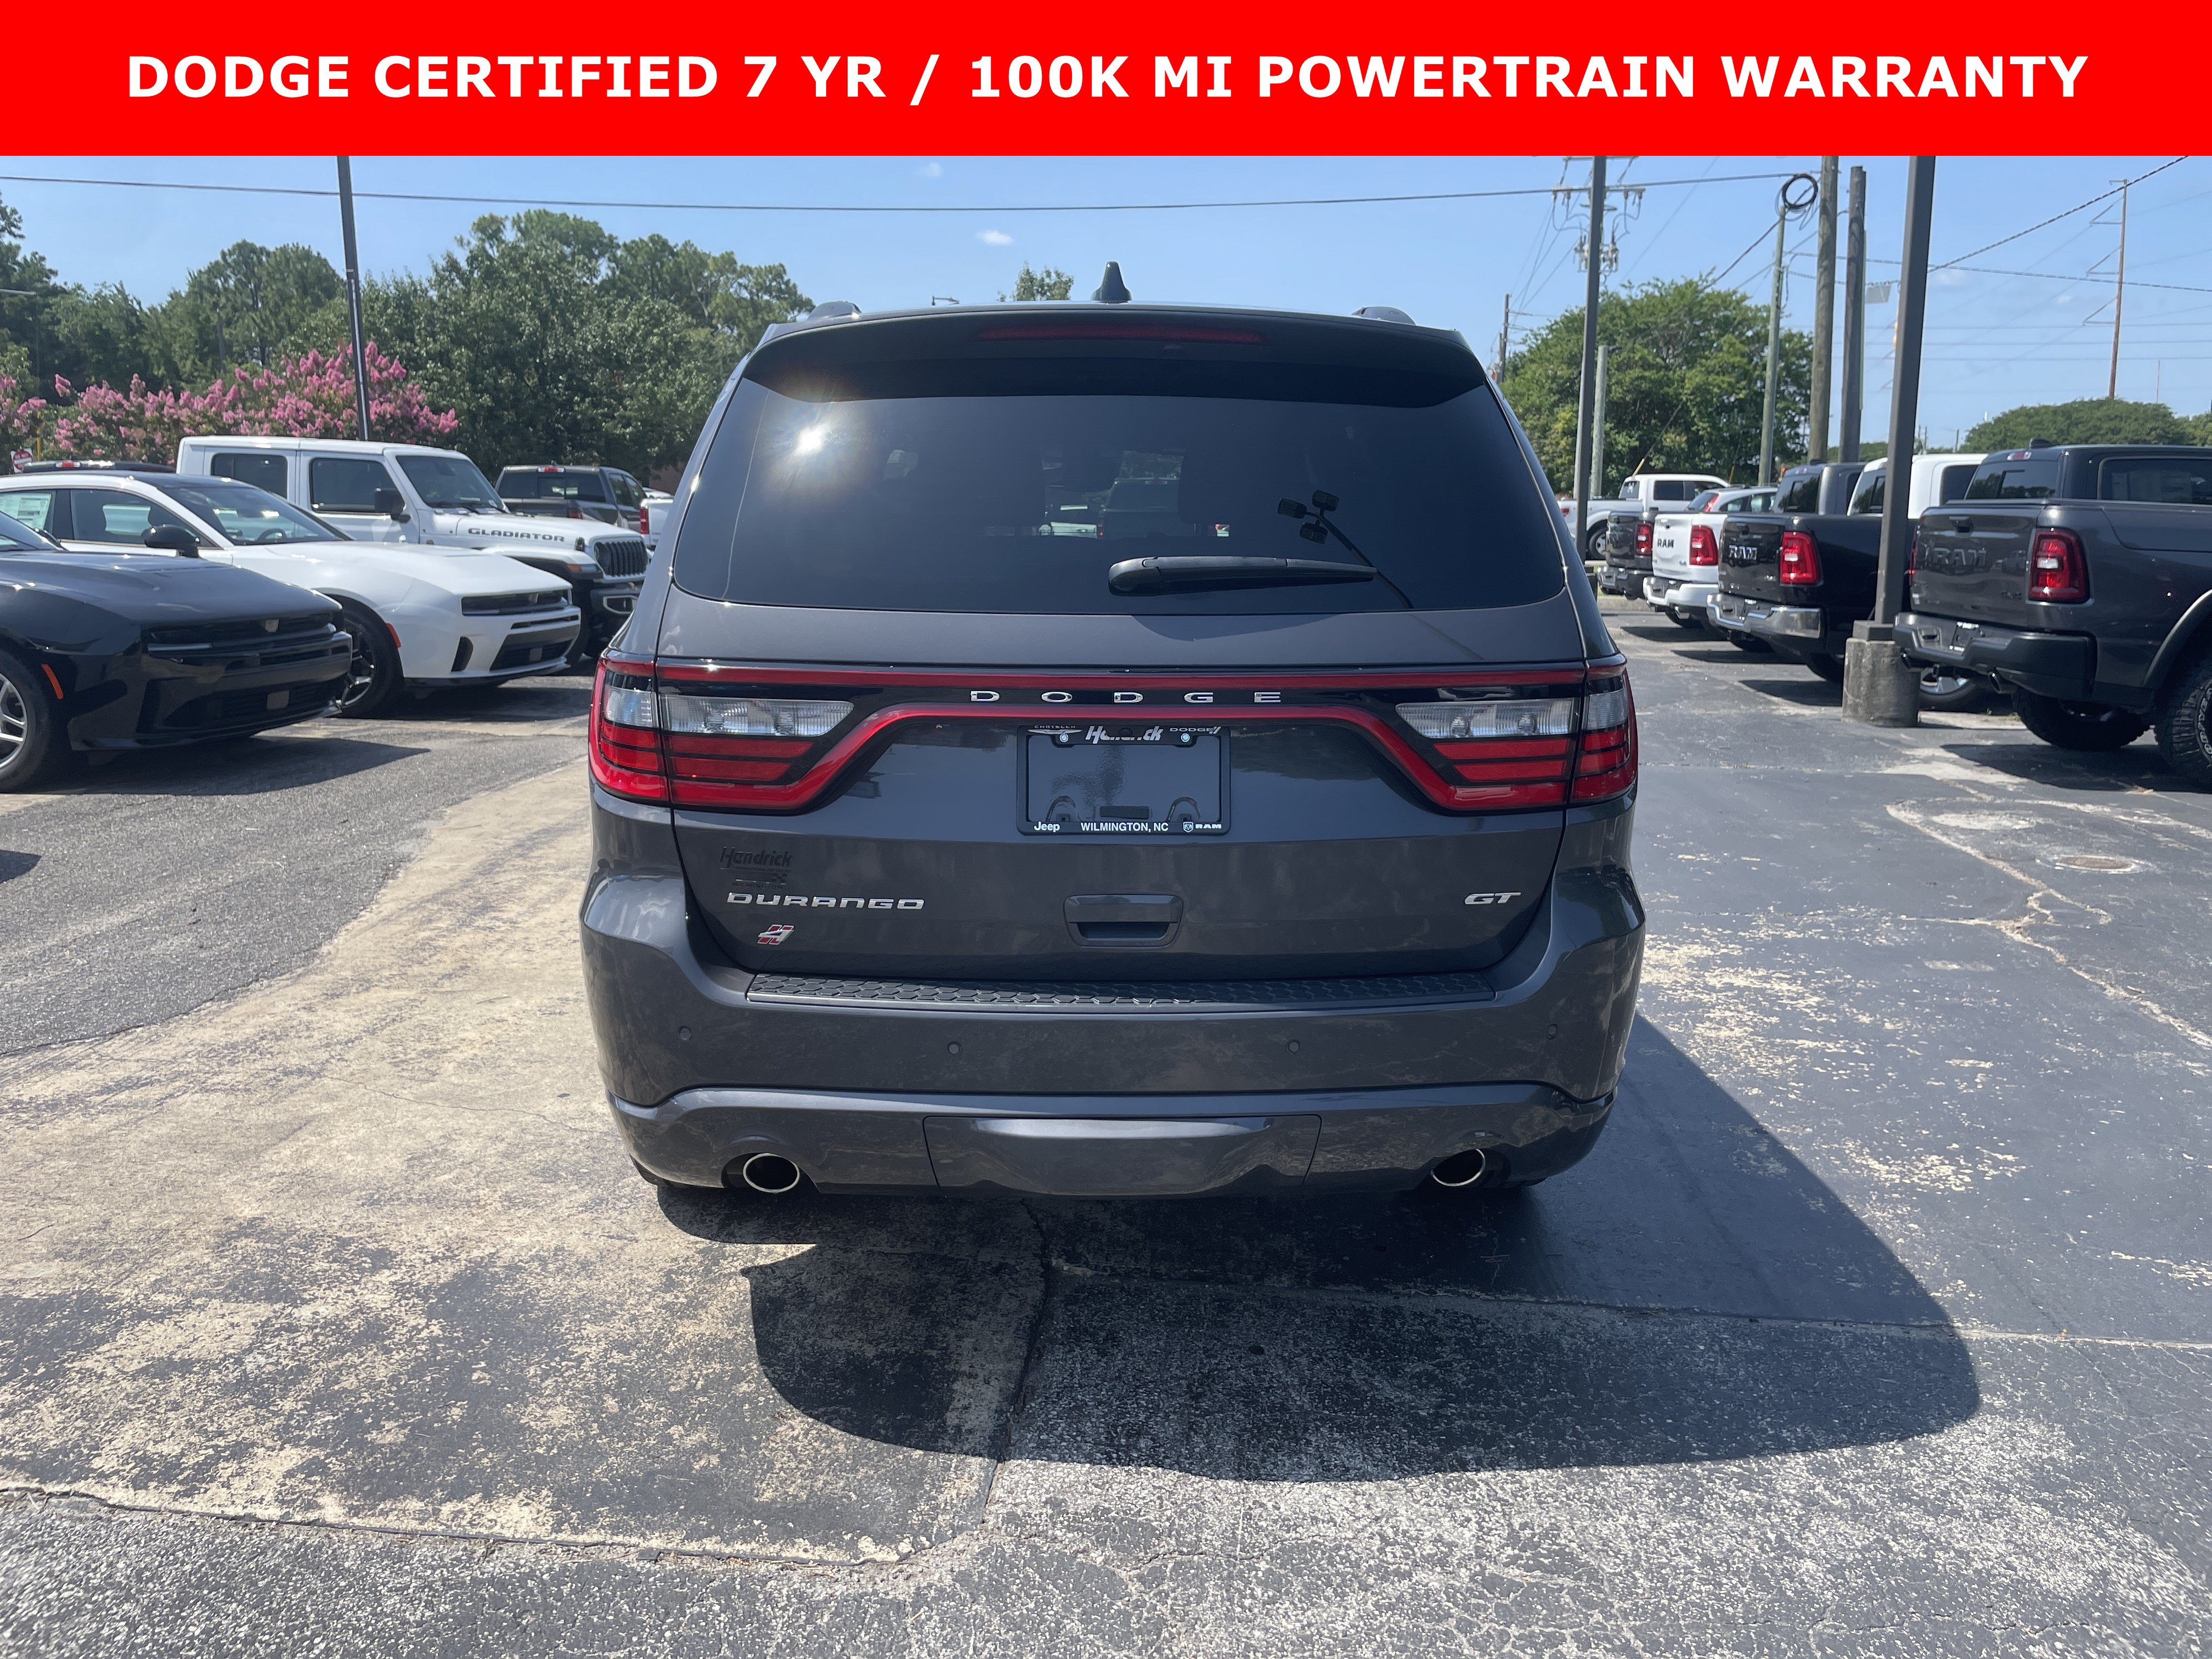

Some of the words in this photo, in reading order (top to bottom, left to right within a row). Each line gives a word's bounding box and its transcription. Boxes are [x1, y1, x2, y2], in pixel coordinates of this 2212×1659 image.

[468, 527, 565, 541] GLADIATOR
[1657, 539, 1674, 548] RAM
[1729, 545, 1758, 560] RAM
[1933, 548, 1987, 567] RAM
[970, 690, 1281, 703] DODGE
[1034, 821, 1060, 832] Jeep
[1081, 822, 1151, 832] WILMINGTON,
[1153, 822, 1169, 831] NC
[719, 846, 793, 868] Hendrick
[727, 892, 925, 910] DURANGO
[1465, 892, 1521, 905] GT
